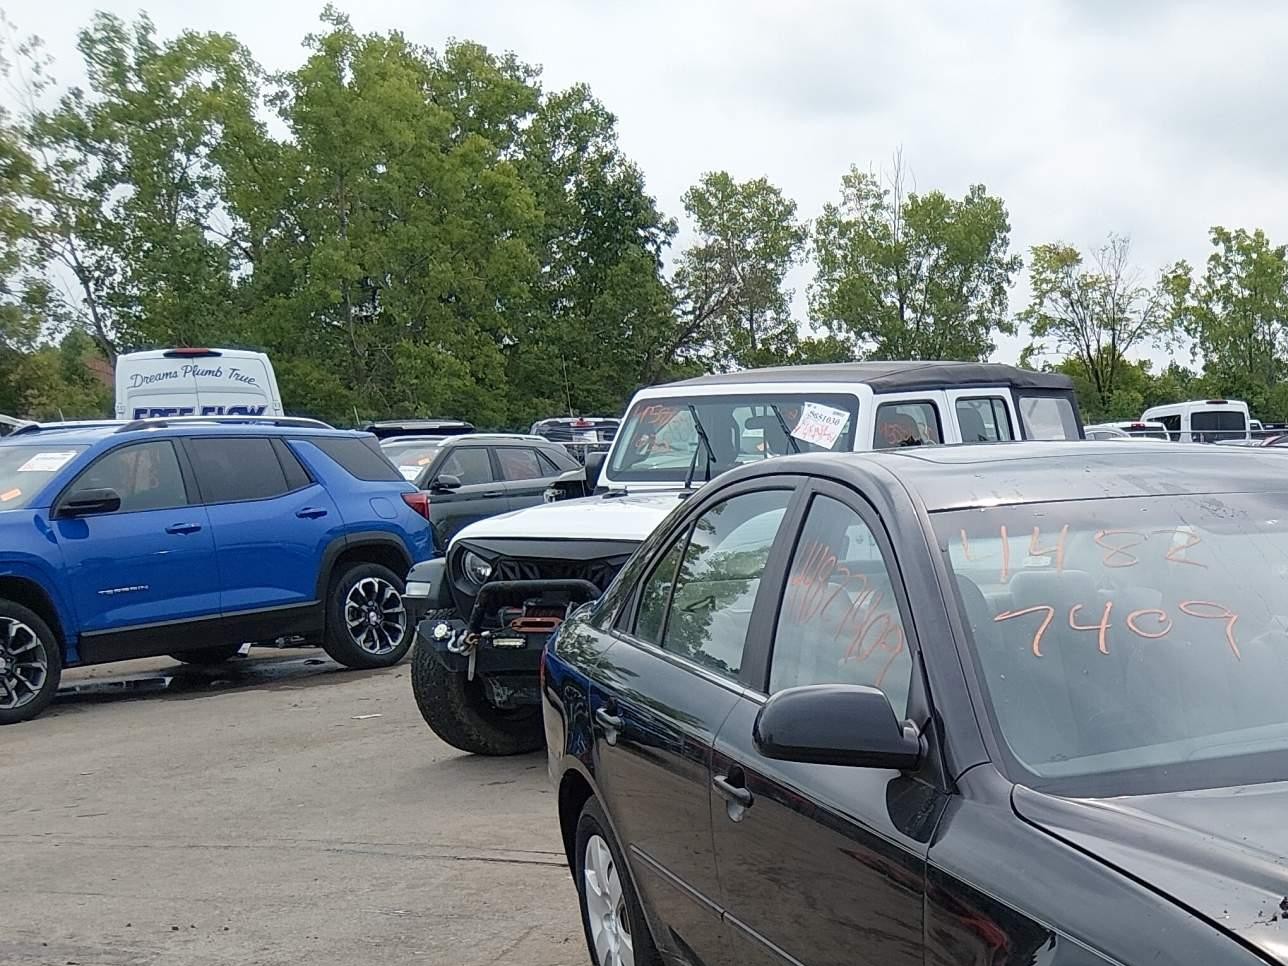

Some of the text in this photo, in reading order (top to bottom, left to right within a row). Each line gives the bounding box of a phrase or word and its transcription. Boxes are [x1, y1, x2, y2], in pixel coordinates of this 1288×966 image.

[128, 365, 259, 389] Dreams Plumb True
[994, 599, 1241, 661] 7409
